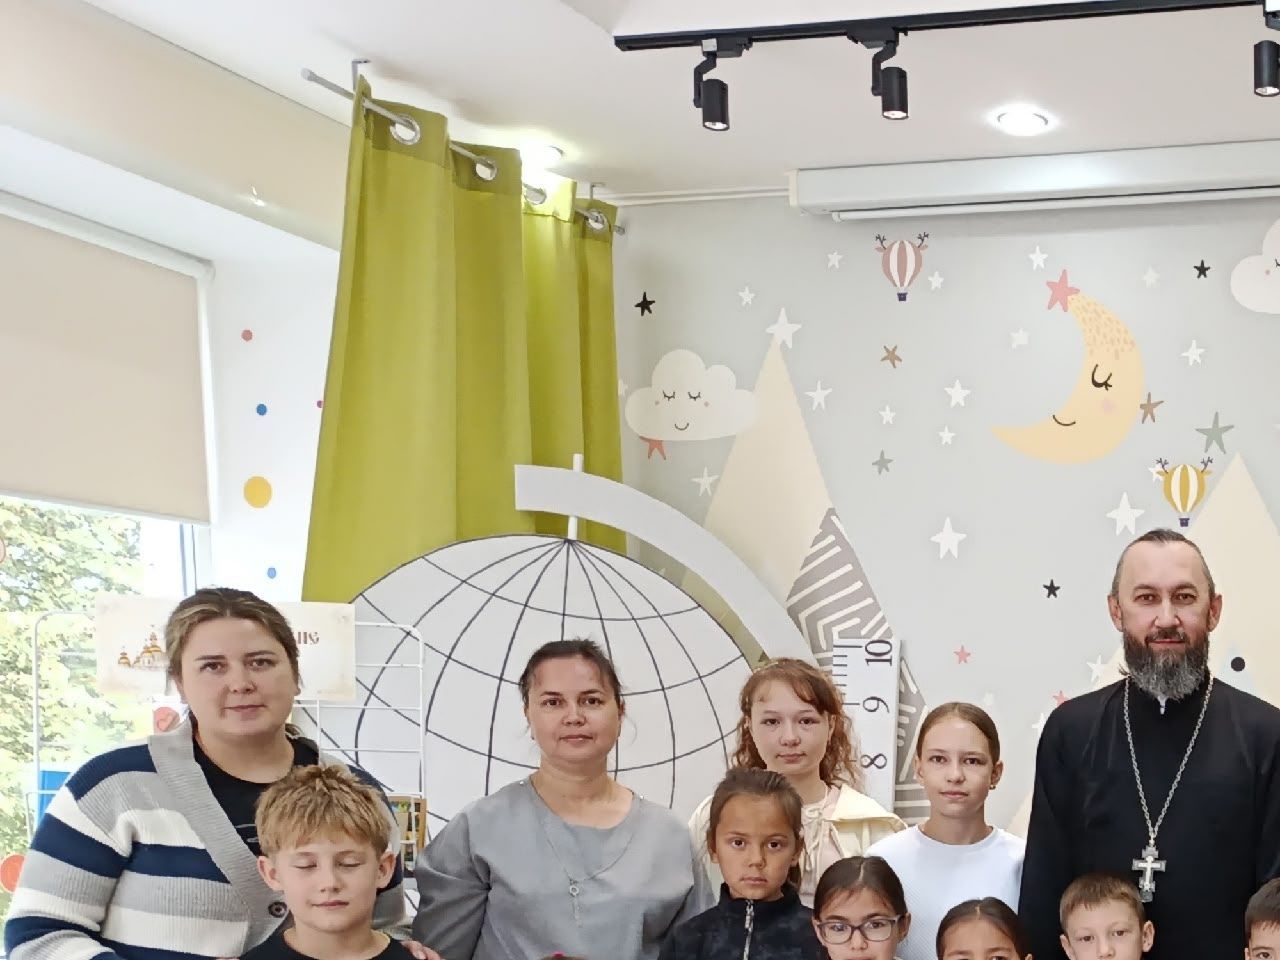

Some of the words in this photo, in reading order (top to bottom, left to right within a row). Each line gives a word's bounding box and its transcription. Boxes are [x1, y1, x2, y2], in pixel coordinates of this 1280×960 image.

[864, 639, 893, 667] 10
[862, 696, 890, 714] 9
[860, 753, 888, 770] 8
